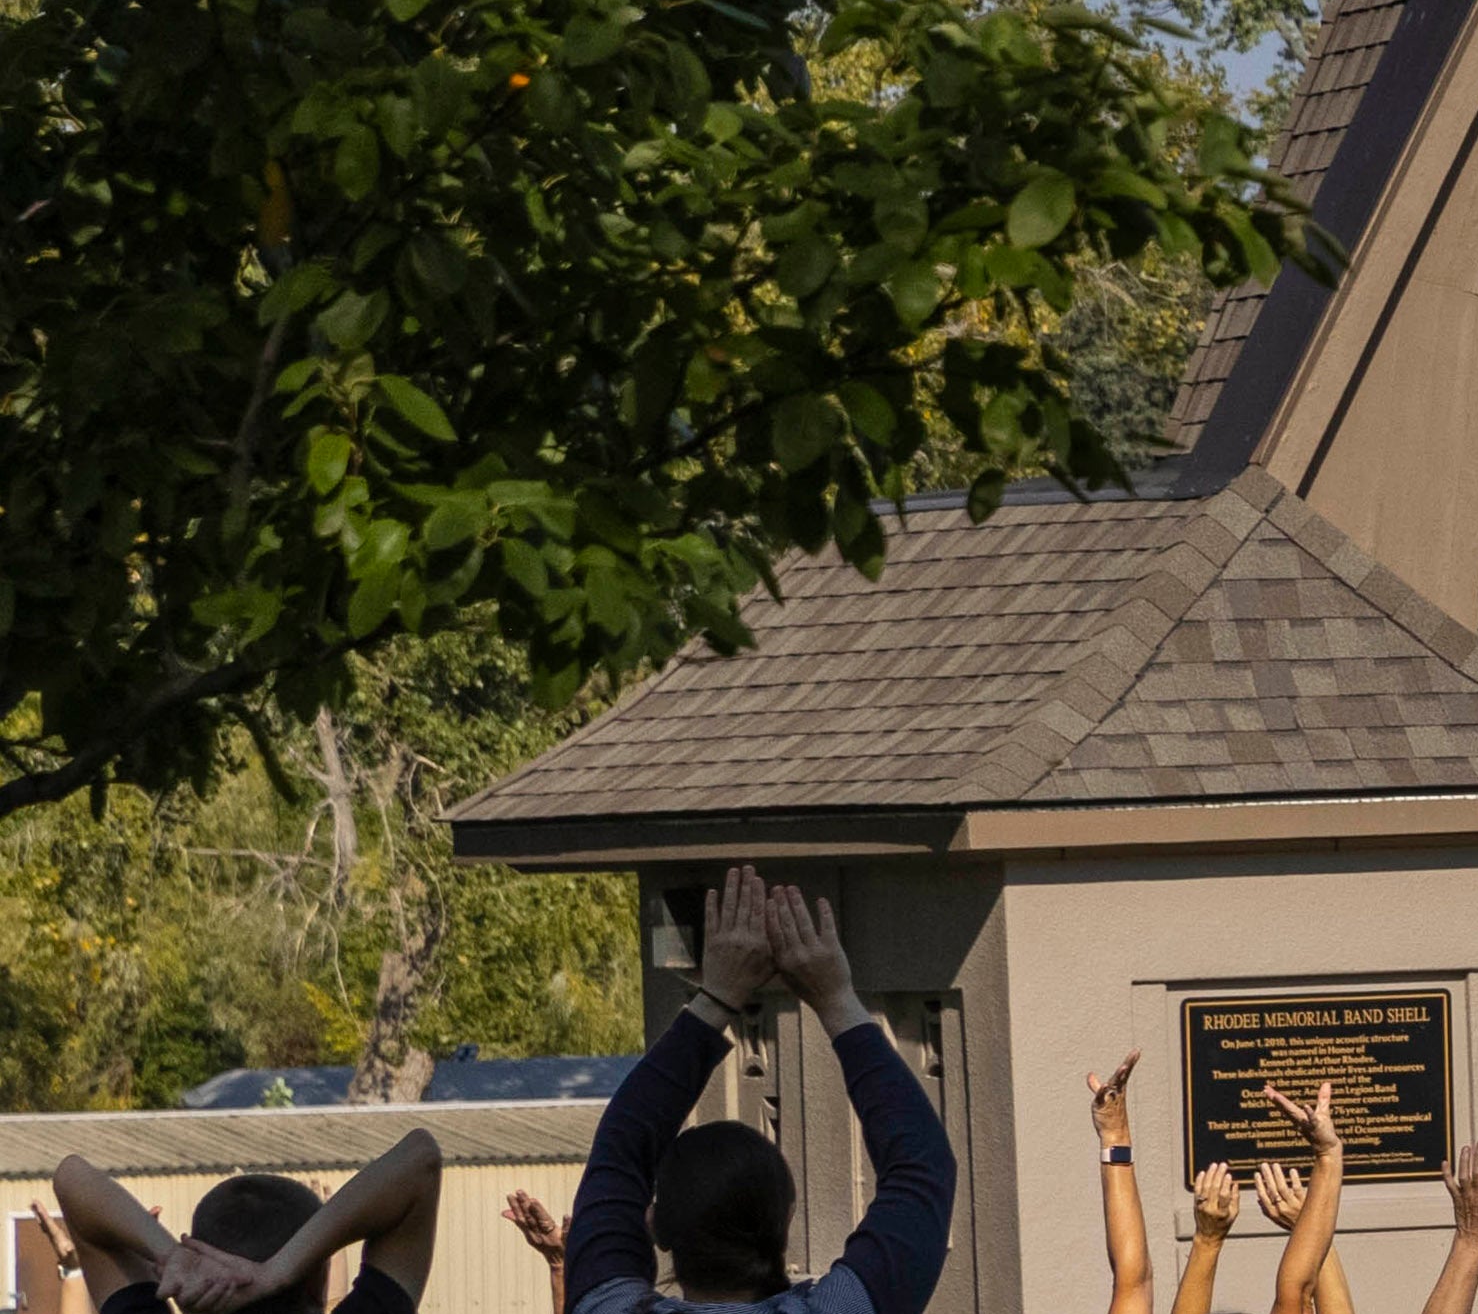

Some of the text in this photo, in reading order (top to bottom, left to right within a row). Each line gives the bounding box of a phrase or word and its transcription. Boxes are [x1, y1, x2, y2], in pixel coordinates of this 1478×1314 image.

[1203, 1007, 1430, 1030] RHODEE MEMORIAL BAND SHELL
[1289, 1036, 1304, 1046] this
[1305, 1036, 1334, 1046] unique
[1336, 1034, 1369, 1044] acoustic
[1371, 1035, 1409, 1043] structure
[1271, 1049, 1287, 1057] was
[1288, 1047, 1317, 1057] named
[1327, 1045, 1354, 1054] Honor
[1260, 1058, 1295, 1067] Kenneth
[1296, 1056, 1312, 1066] and
[1314, 1055, 1341, 1065] Arthur
[1212, 1070, 1237, 1080] These
[1238, 1068, 1283, 1079] individuals
[1284, 1067, 1326, 1077] dedicated
[1327, 1065, 1346, 1075] their
[1368, 1064, 1383, 1074] and
[1384, 1064, 1426, 1073] resources
[1277, 1078, 1290, 1087] the
[1358, 1075, 1372, 1084] the
[1345, 1086, 1374, 1096] Legion
[1375, 1083, 1397, 1093] Band
[1239, 1099, 1265, 1108] which
[1362, 1095, 1399, 1104] concerts
[1207, 1121, 1230, 1131] Their
[1366, 1114, 1398, 1126] provide
[1400, 1112, 1432, 1122] musical
[1225, 1131, 1286, 1139] entertainment
